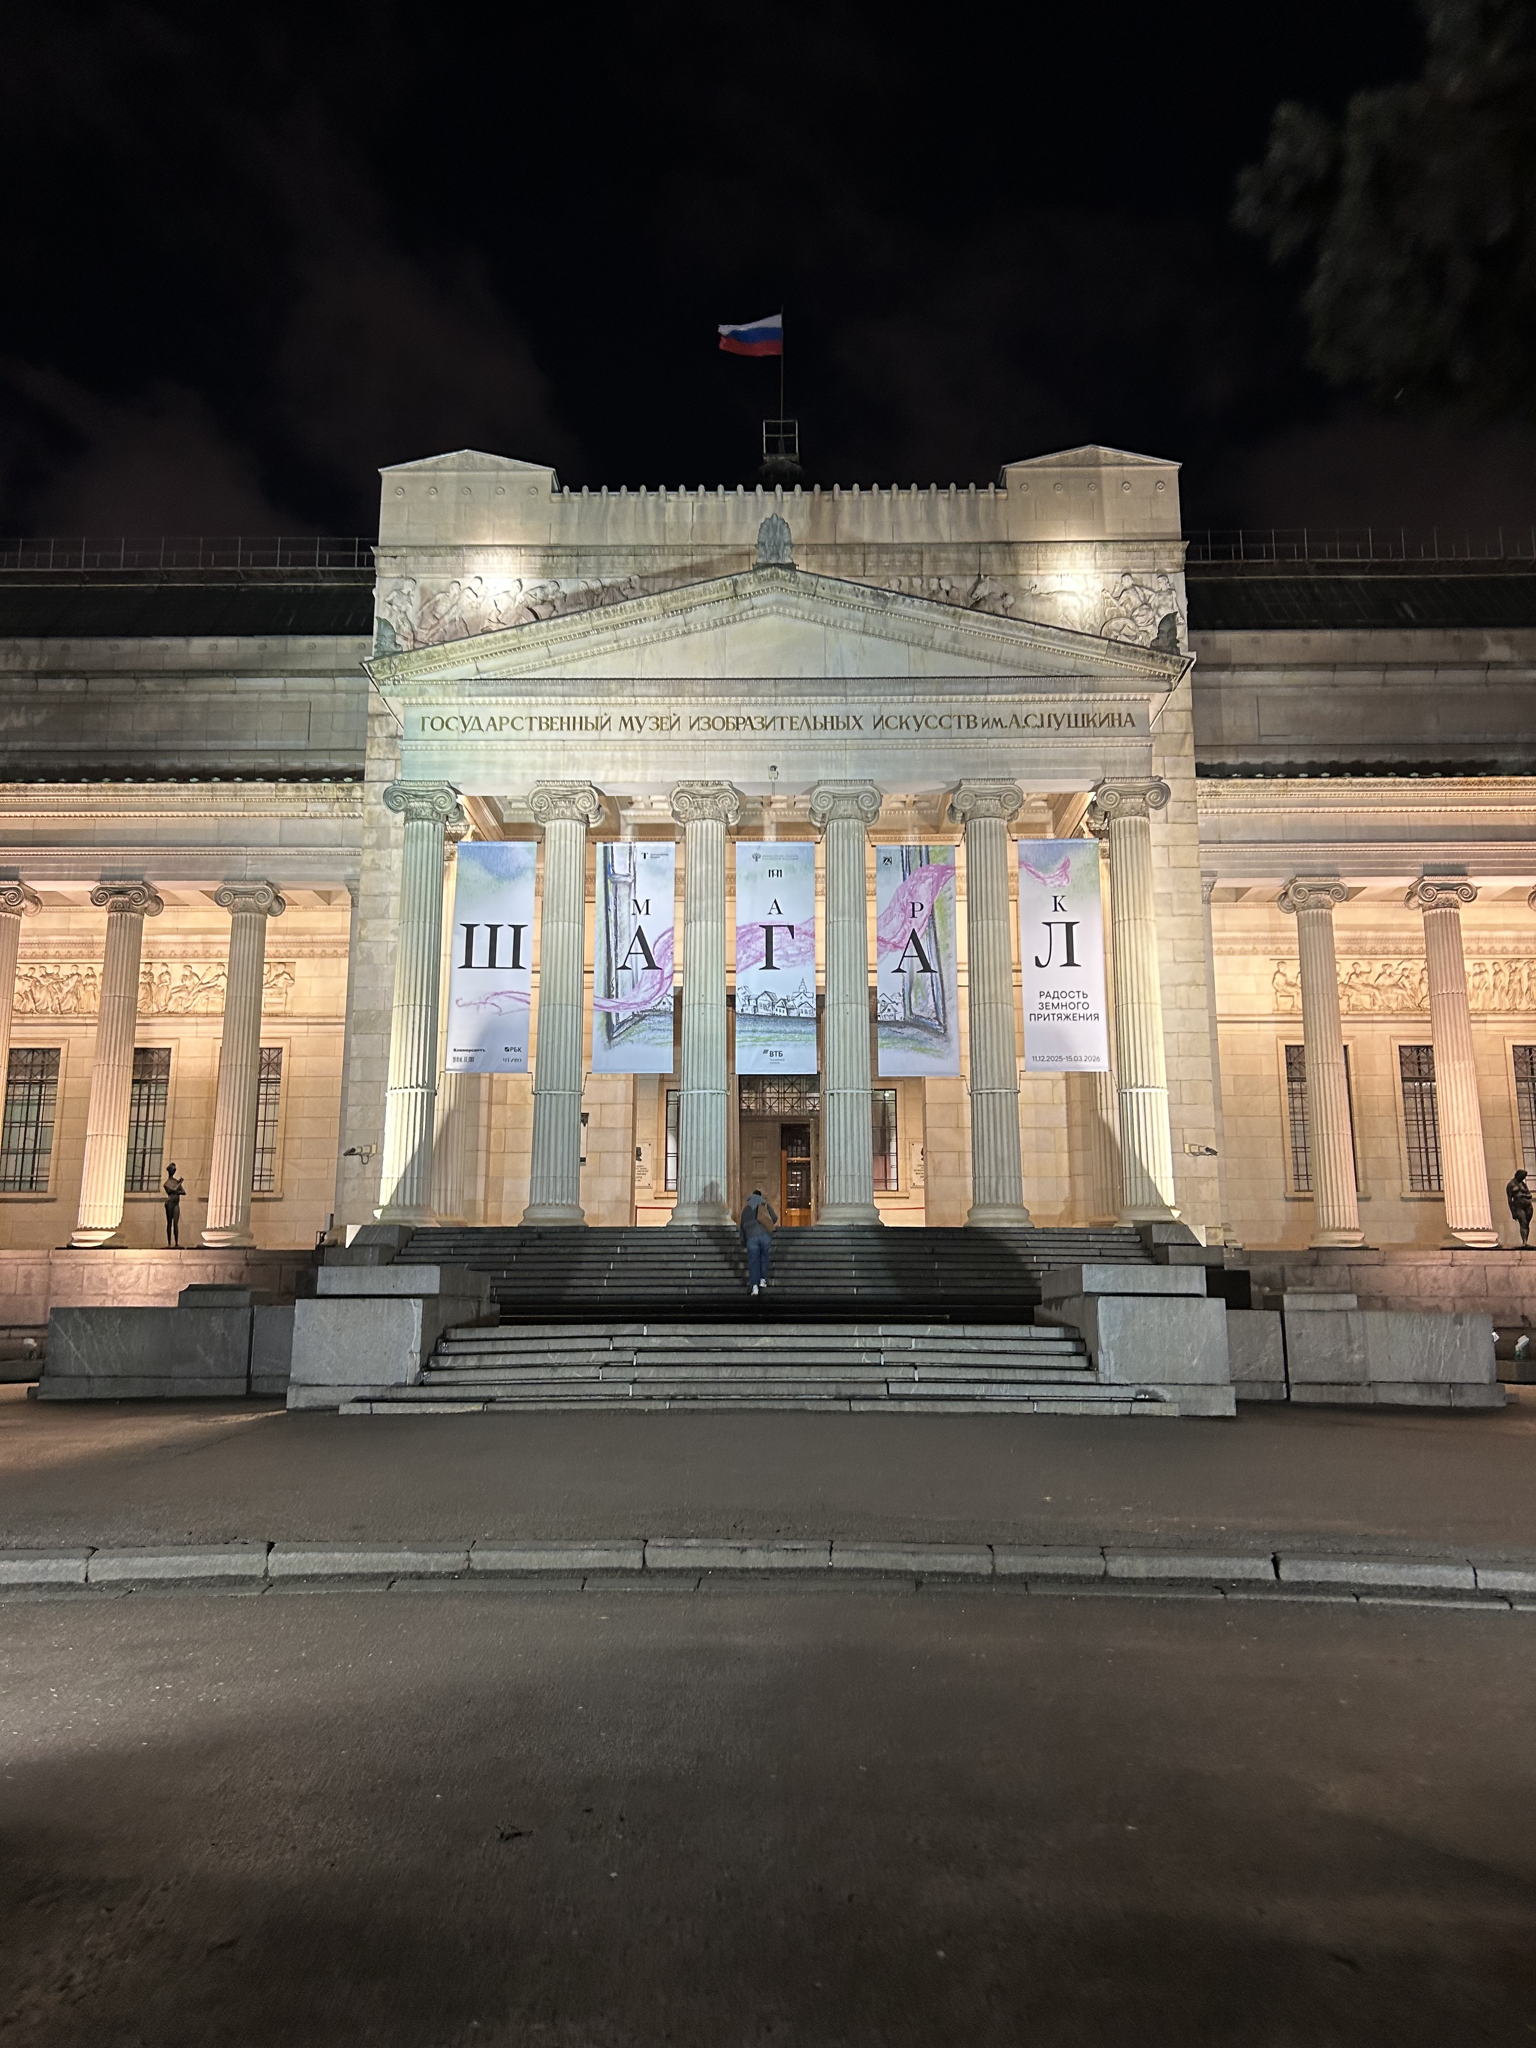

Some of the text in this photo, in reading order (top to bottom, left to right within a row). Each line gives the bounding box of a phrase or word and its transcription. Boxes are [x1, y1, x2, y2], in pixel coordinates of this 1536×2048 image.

[420, 712, 612, 733] ГОСУДАРСТВЕННЫЙ
[618, 712, 681, 732] МУЗЕЙ
[688, 714, 864, 732] ИЗОБРАЗИТЕЛЬНЫХ
[872, 714, 978, 732] ИСКУССТВ
[631, 899, 651, 916] М
[767, 898, 784, 915] А
[909, 902, 924, 918] Р
[1052, 895, 1067, 912] К
[457, 923, 529, 970] Ш
[616, 925, 664, 970] А
[758, 924, 795, 971] Г
[891, 928, 938, 973] А
[1034, 921, 1082, 968] Л
[1039, 990, 1089, 1000] РАДОСТЬ
[1038, 1001, 1090, 1011] ЗЕМНОГО
[1029, 1013, 1100, 1022] ПРИТЯЖЕНИЯ
